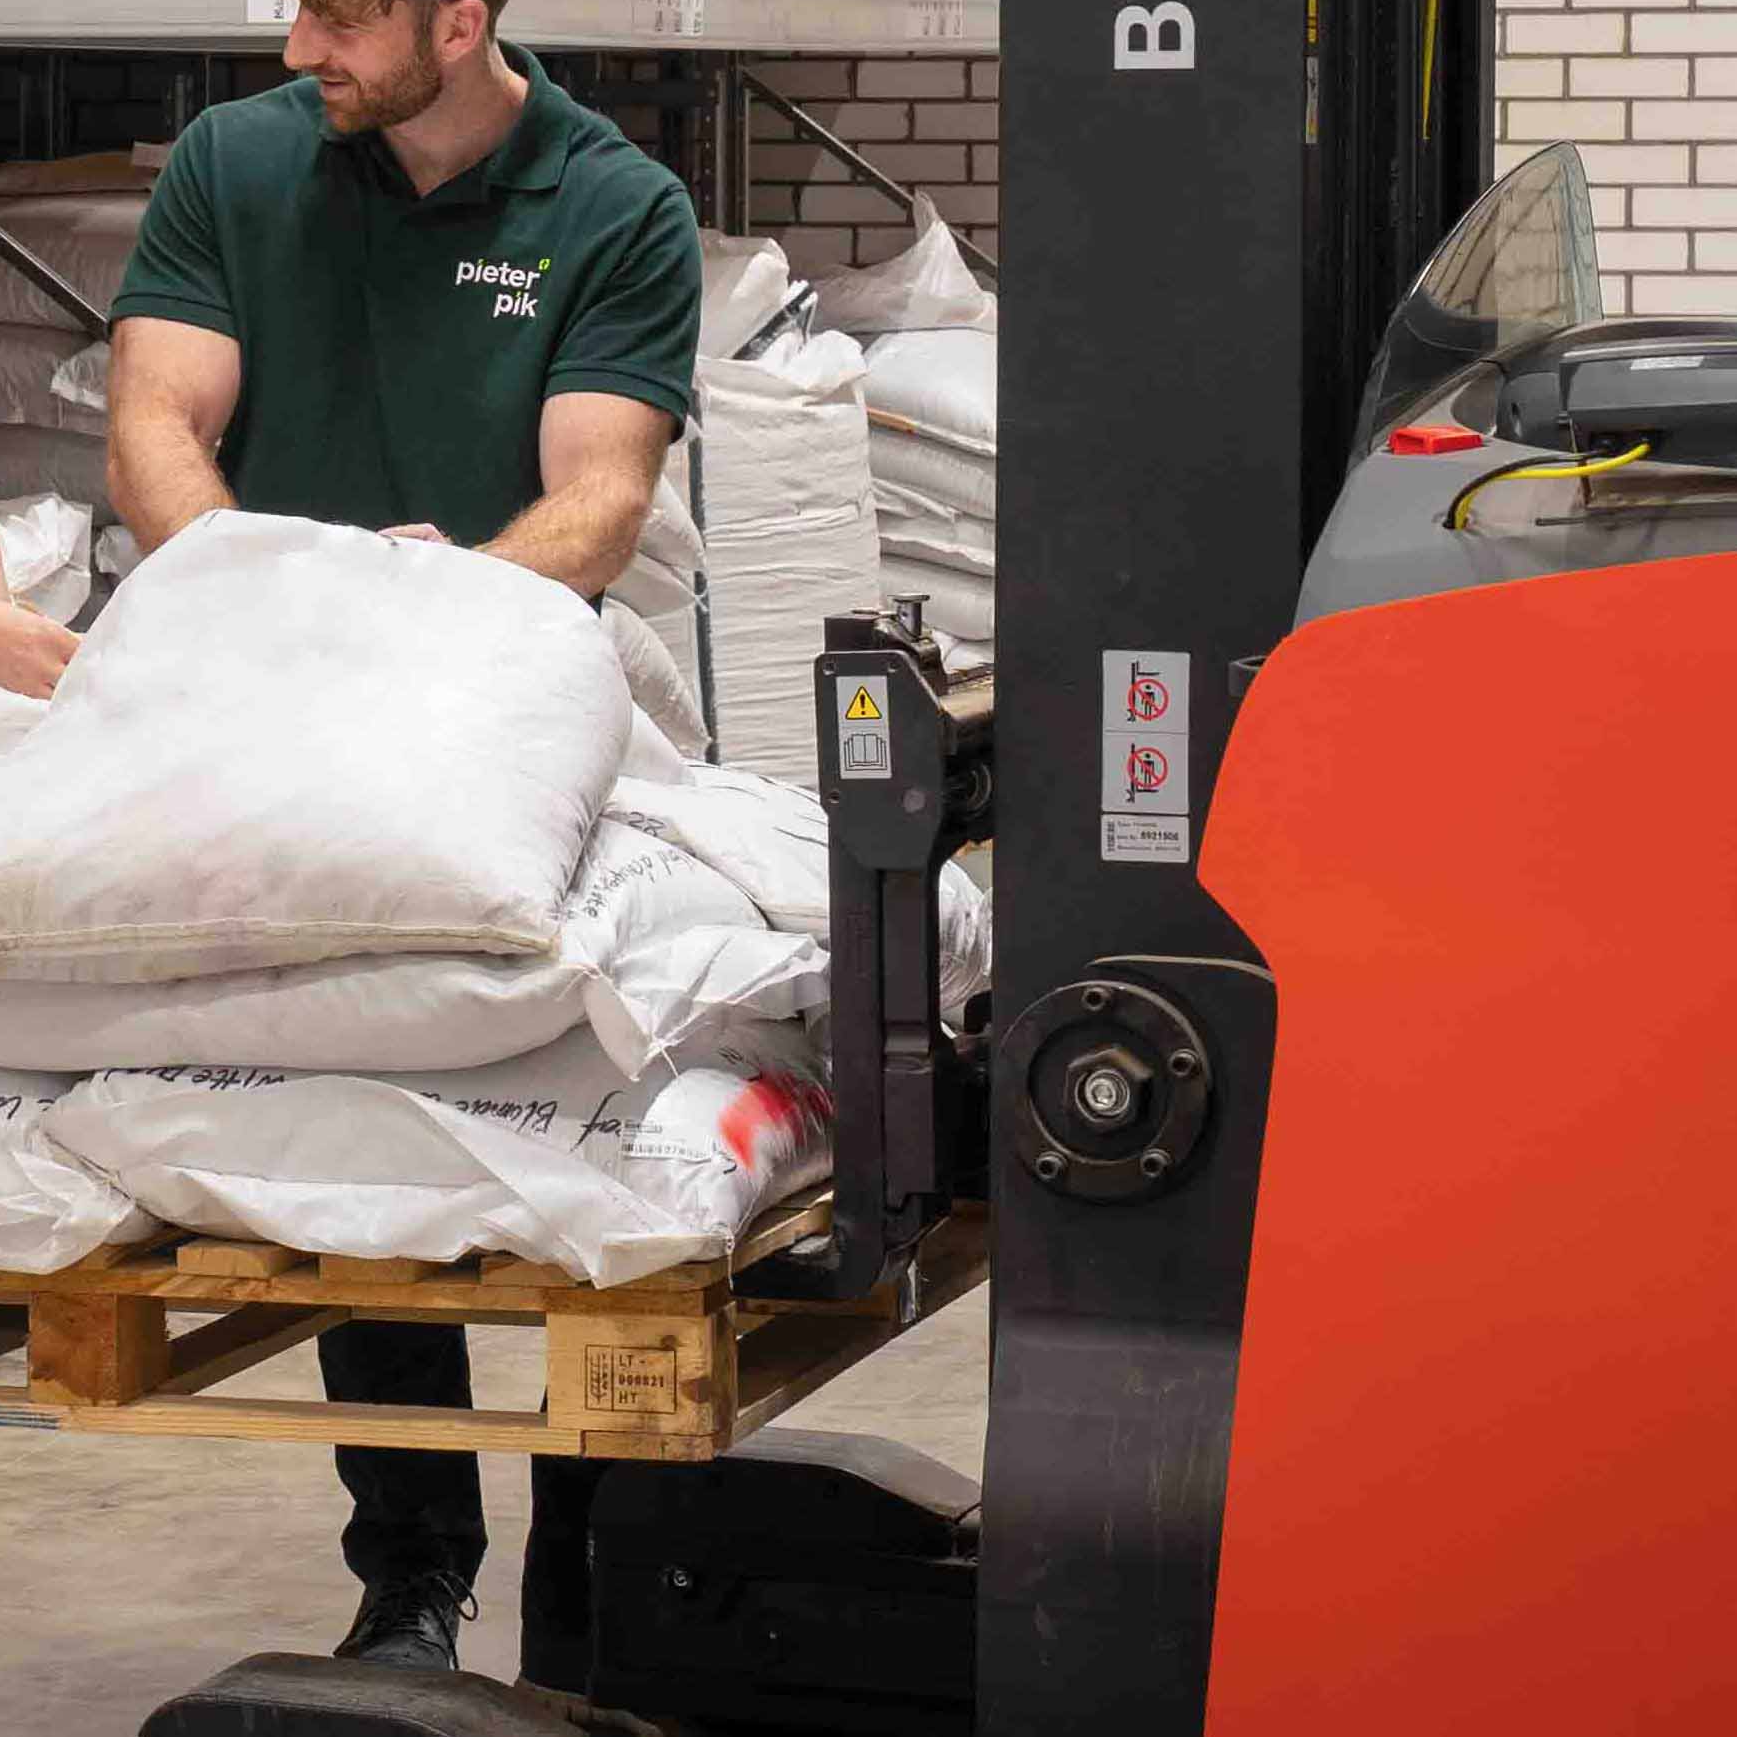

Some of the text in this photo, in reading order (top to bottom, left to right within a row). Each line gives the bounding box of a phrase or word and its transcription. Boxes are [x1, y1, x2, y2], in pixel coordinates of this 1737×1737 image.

[455, 258, 541, 290] pieter
[493, 291, 538, 319] pik
[619, 1354, 634, 1368] LT
[619, 1391, 638, 1404] HT
